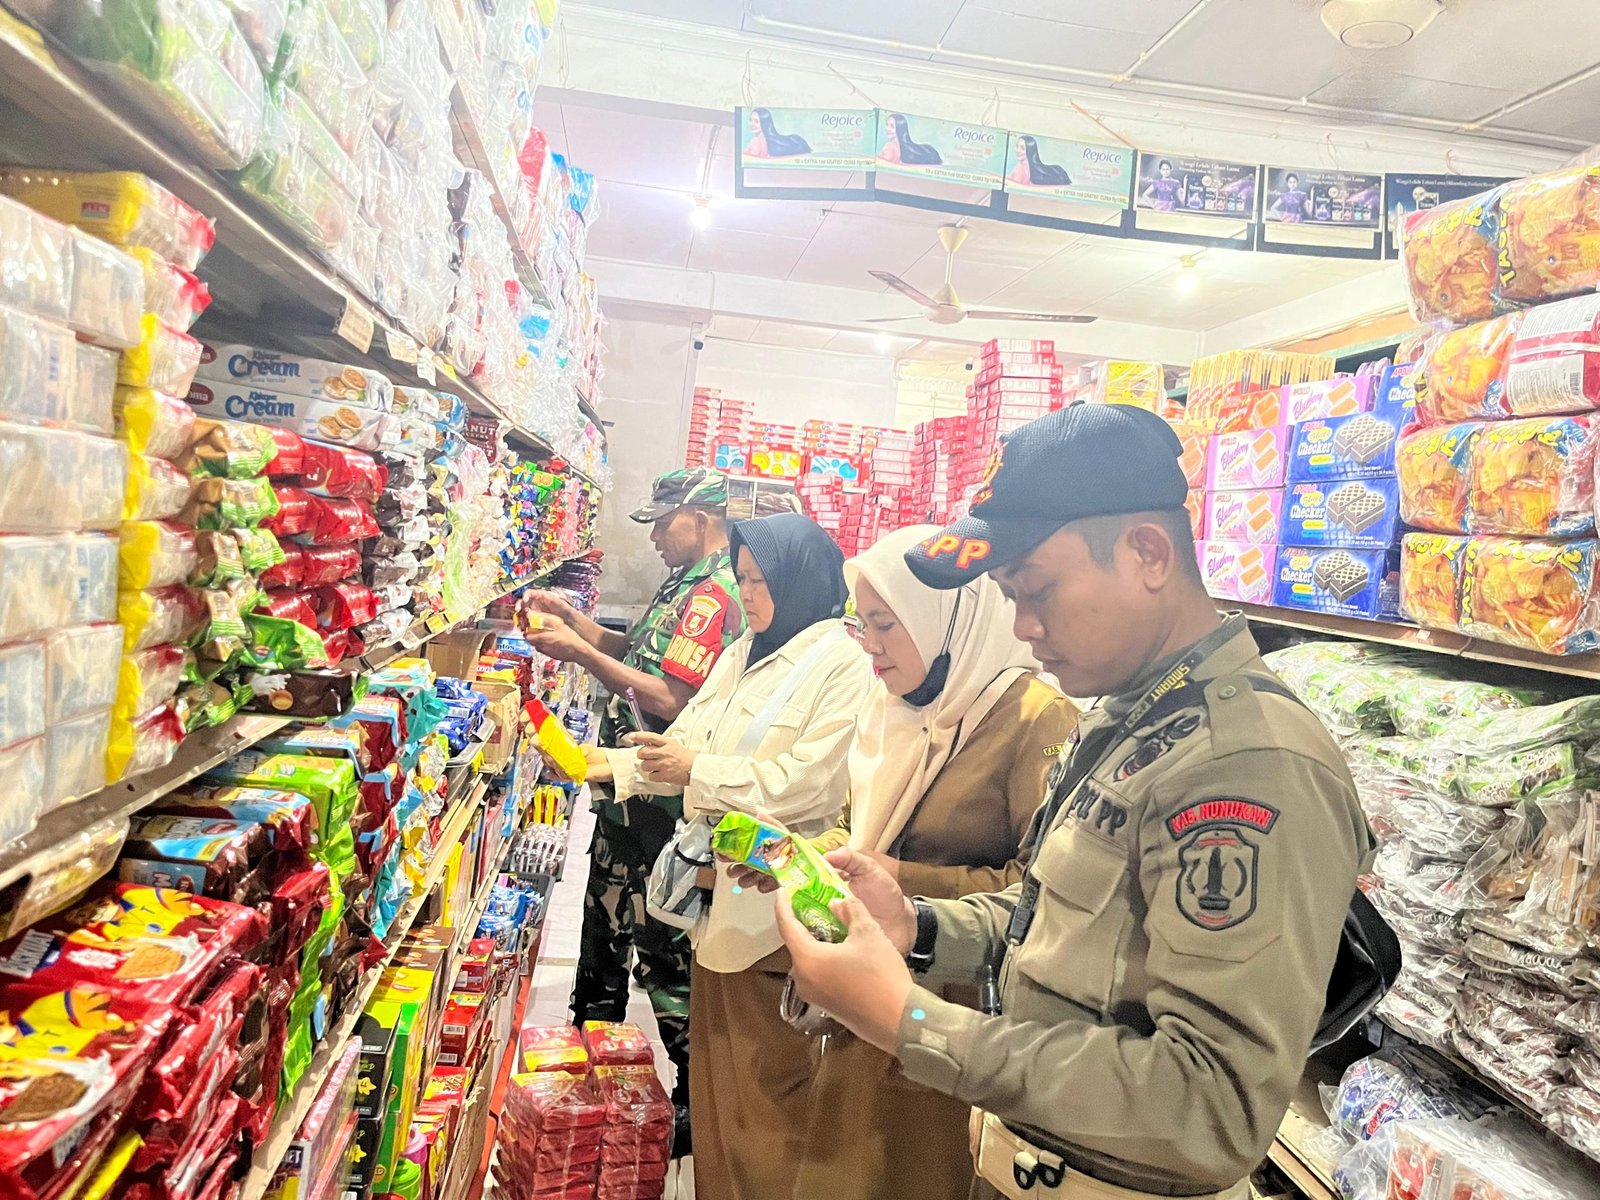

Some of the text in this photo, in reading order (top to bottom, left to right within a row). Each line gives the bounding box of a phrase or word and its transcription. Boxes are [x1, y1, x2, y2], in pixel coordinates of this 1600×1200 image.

[821, 113, 862, 128] Rejoice
[954, 127, 994, 143] Rejoice
[1083, 148, 1121, 163] Rejoice
[228, 354, 301, 378] Cream
[224, 394, 296, 418] Cream
[1220, 436, 1237, 446] APOLLO
[1298, 440, 1332, 456] Checker
[1216, 494, 1232, 502] APOLLO
[1216, 500, 1242, 528] Blueberry
[1290, 502, 1325, 519] Checker
[1207, 552, 1235, 578] Blueberry
[1280, 566, 1313, 584] Checker
[1171, 800, 1272, 833] KAB. NUNUKAN
